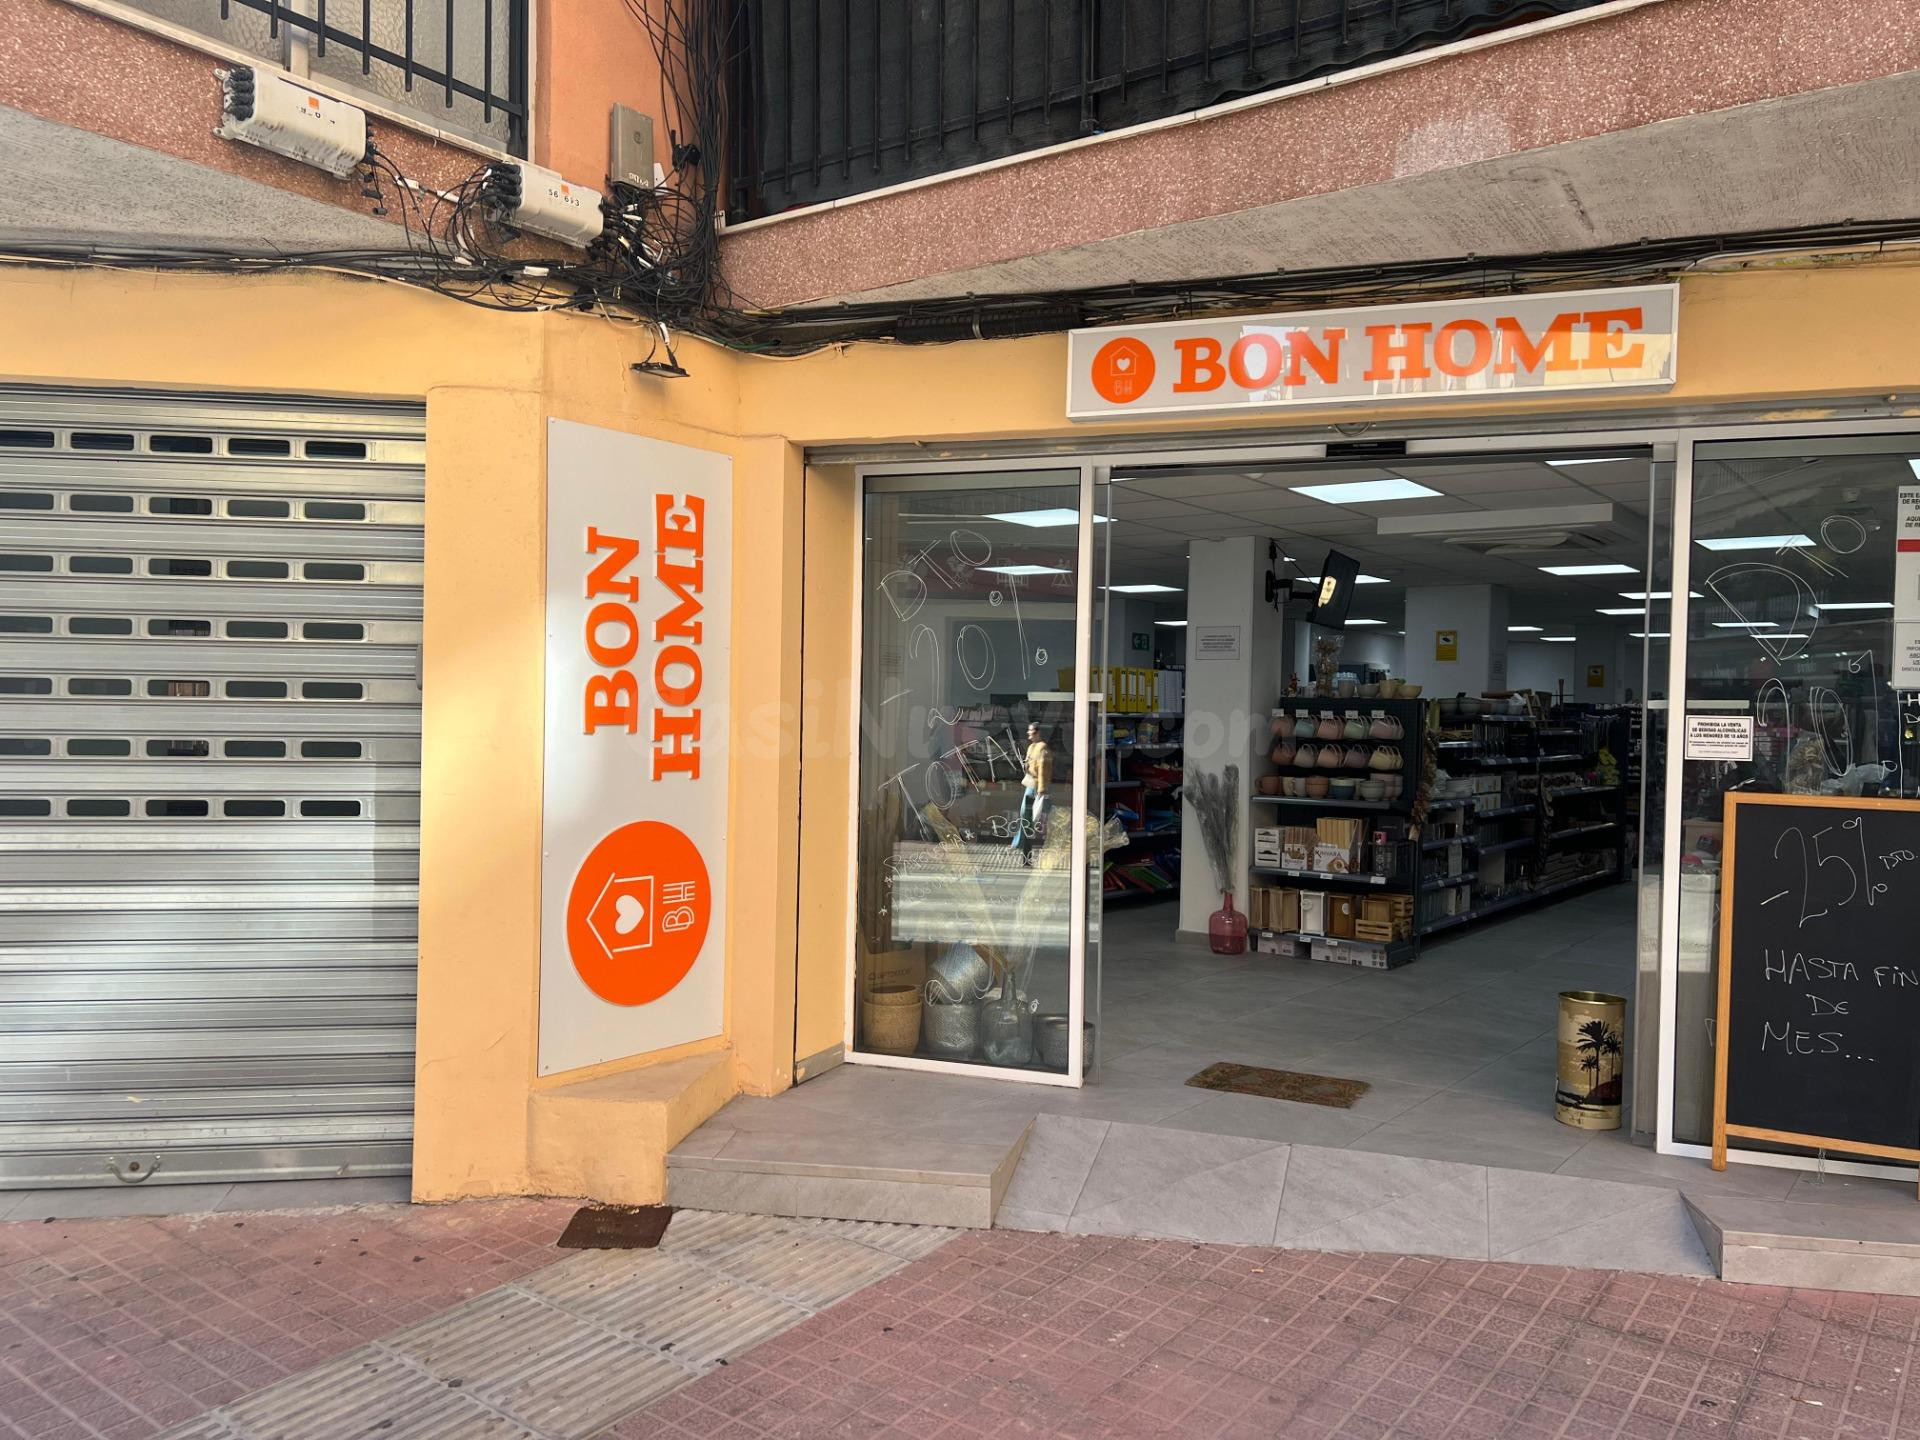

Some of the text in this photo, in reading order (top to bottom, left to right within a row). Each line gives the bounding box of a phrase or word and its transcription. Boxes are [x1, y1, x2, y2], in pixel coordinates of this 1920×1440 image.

[1173, 329, 1345, 393] BON
[1364, 307, 1645, 382] HOME
[876, 529, 993, 622] DTO
[1705, 514, 1867, 666] DTO
[584, 526, 641, 735] BON
[651, 494, 706, 782] HOME
[877, 727, 1028, 841] TOTAL
[661, 879, 697, 933] BH
[1764, 949, 1860, 985] HASTA
[1805, 993, 1850, 1017] DE
